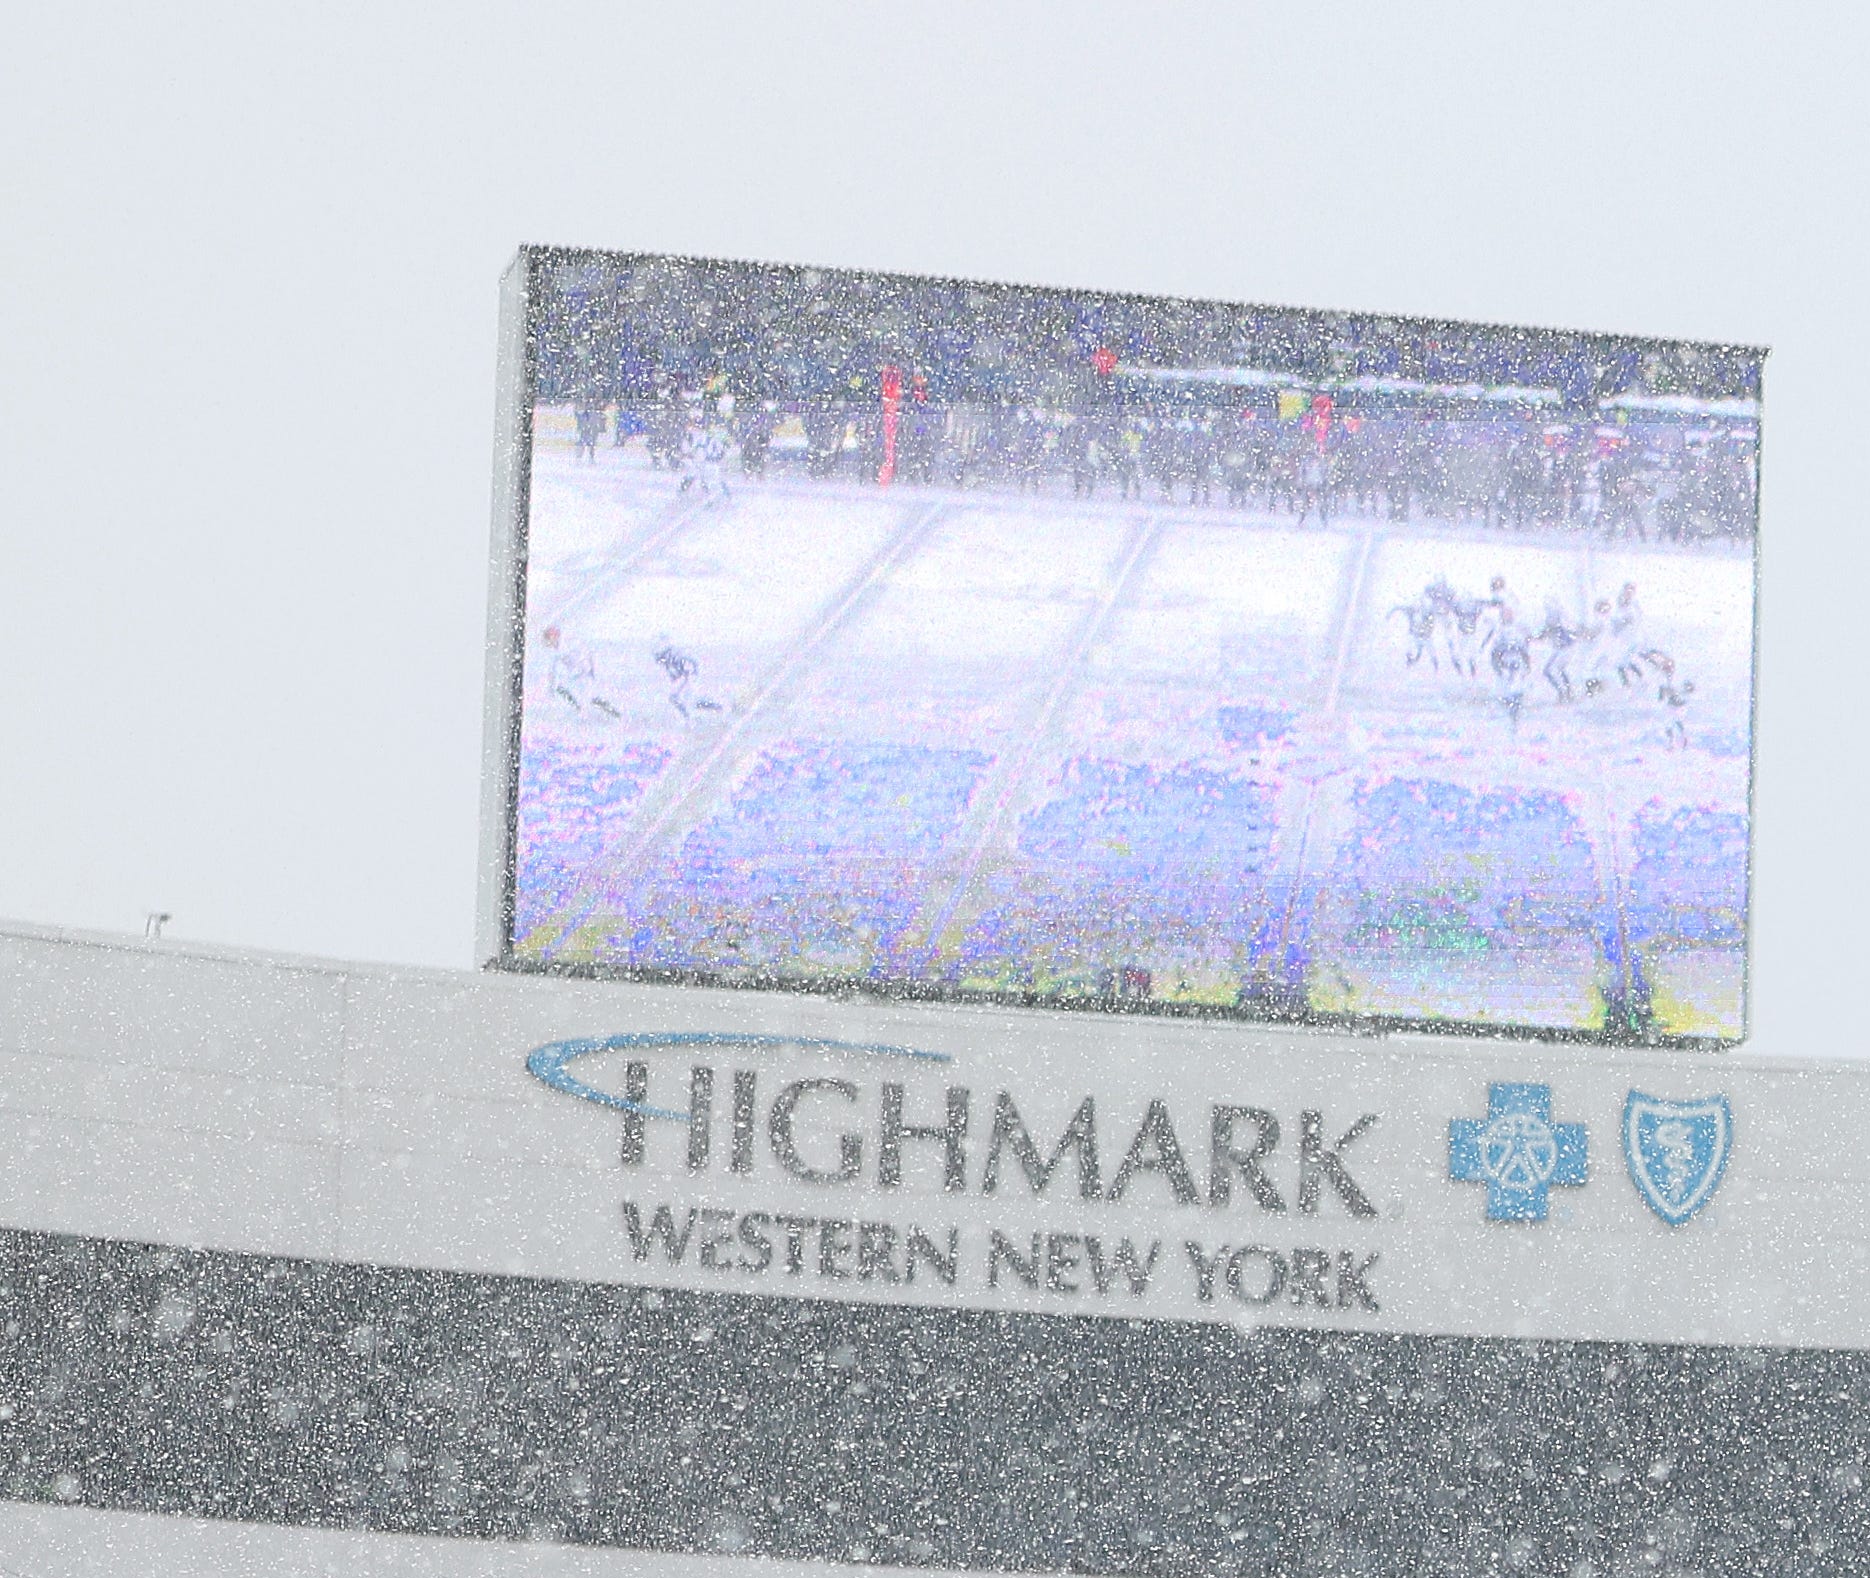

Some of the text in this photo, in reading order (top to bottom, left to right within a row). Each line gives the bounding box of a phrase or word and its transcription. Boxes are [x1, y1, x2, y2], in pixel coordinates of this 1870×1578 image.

[620, 1060, 1381, 1219] HIGHMARK
[621, 1201, 1379, 1313] WESTERN NEW YORK
